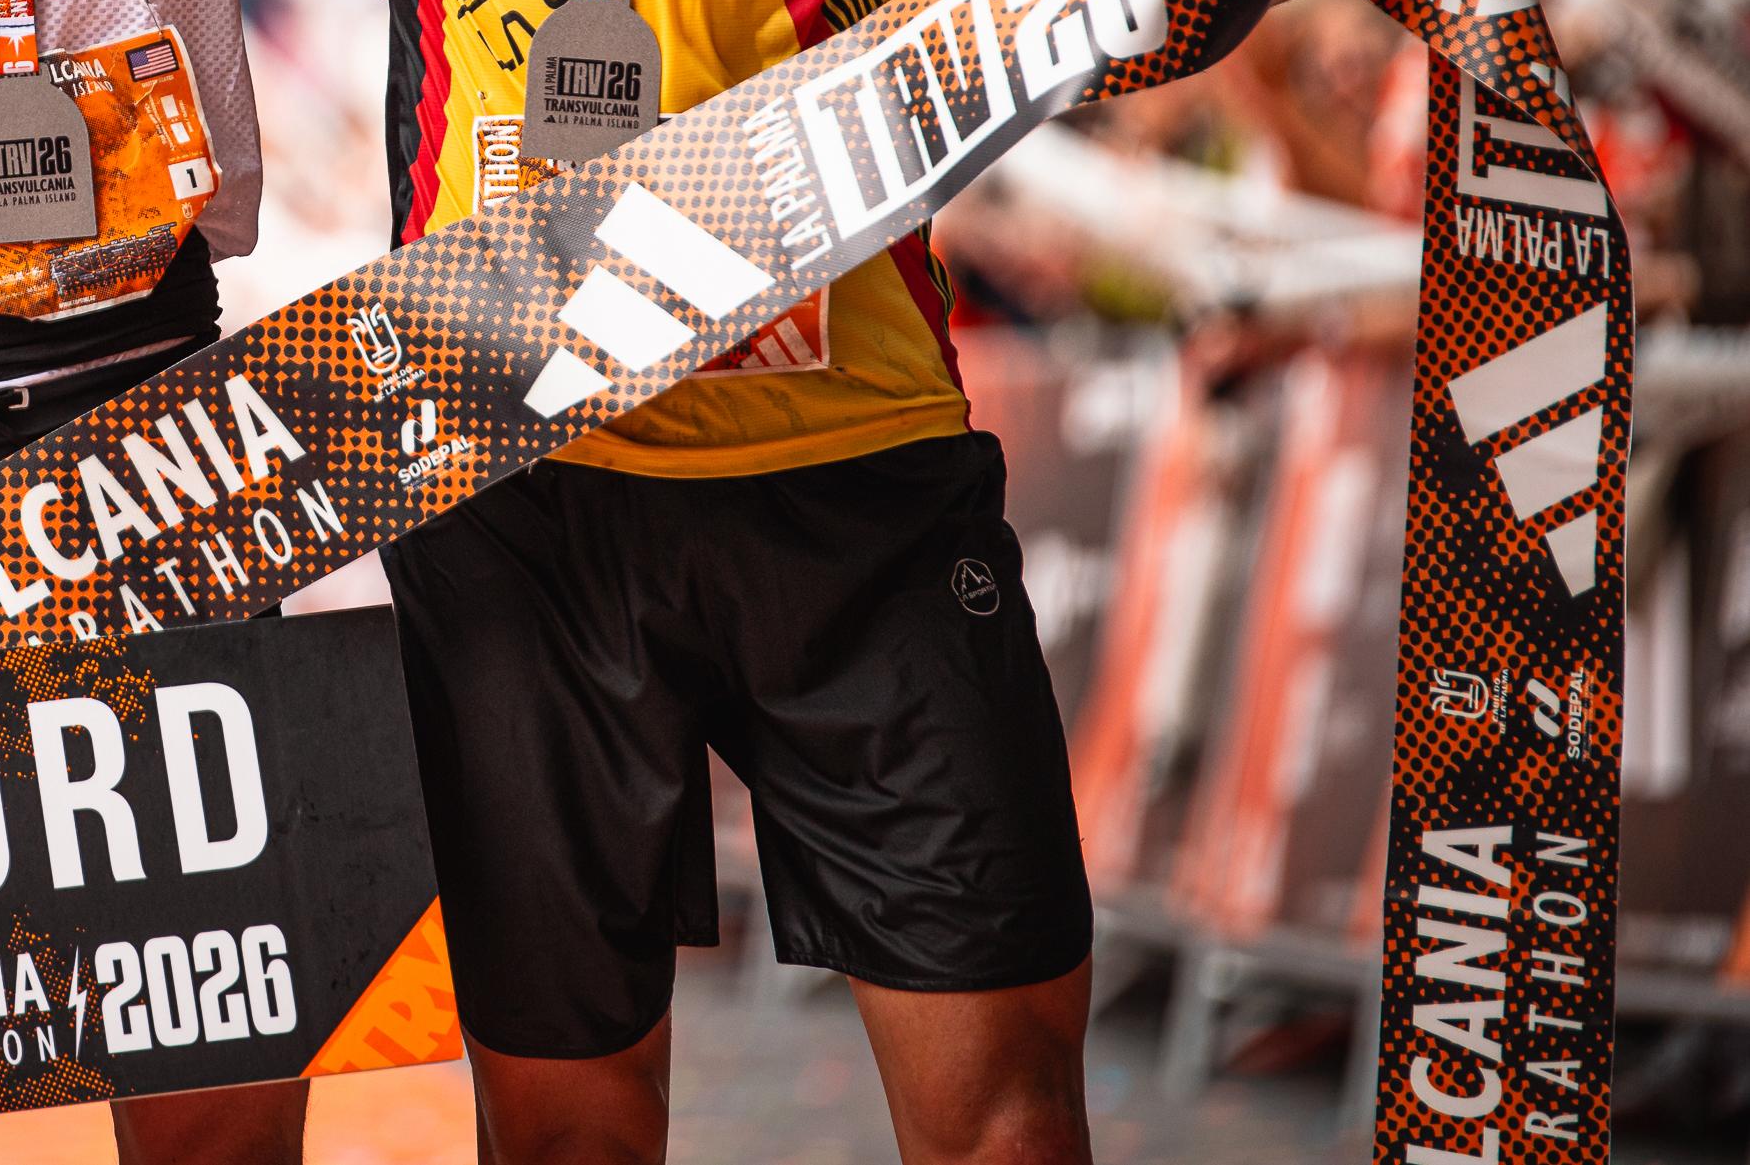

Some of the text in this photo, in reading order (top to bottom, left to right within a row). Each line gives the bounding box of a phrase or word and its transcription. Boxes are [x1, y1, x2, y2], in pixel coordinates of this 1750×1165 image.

[73, 80, 114, 98] ISLAND
[545, 56, 558, 85] PALMA
[559, 58, 642, 101] TRV 26
[544, 98, 640, 118] TRANSVULCANIA
[558, 114, 639, 130] LA PALMA ISLAND
[38, 136, 73, 176] 26
[186, 168, 198, 189] 1
[741, 95, 835, 271] LA PALMA
[13, 195, 41, 207] PALMA
[45, 192, 76, 203] ISLAND
[1455, 204, 1611, 279] LA PALMA
[397, 434, 475, 485] SODEPAL
[1567, 666, 1585, 760] SODEPAL
[95, 923, 299, 1056] 2026
[1524, 831, 1590, 1142] RATHON
